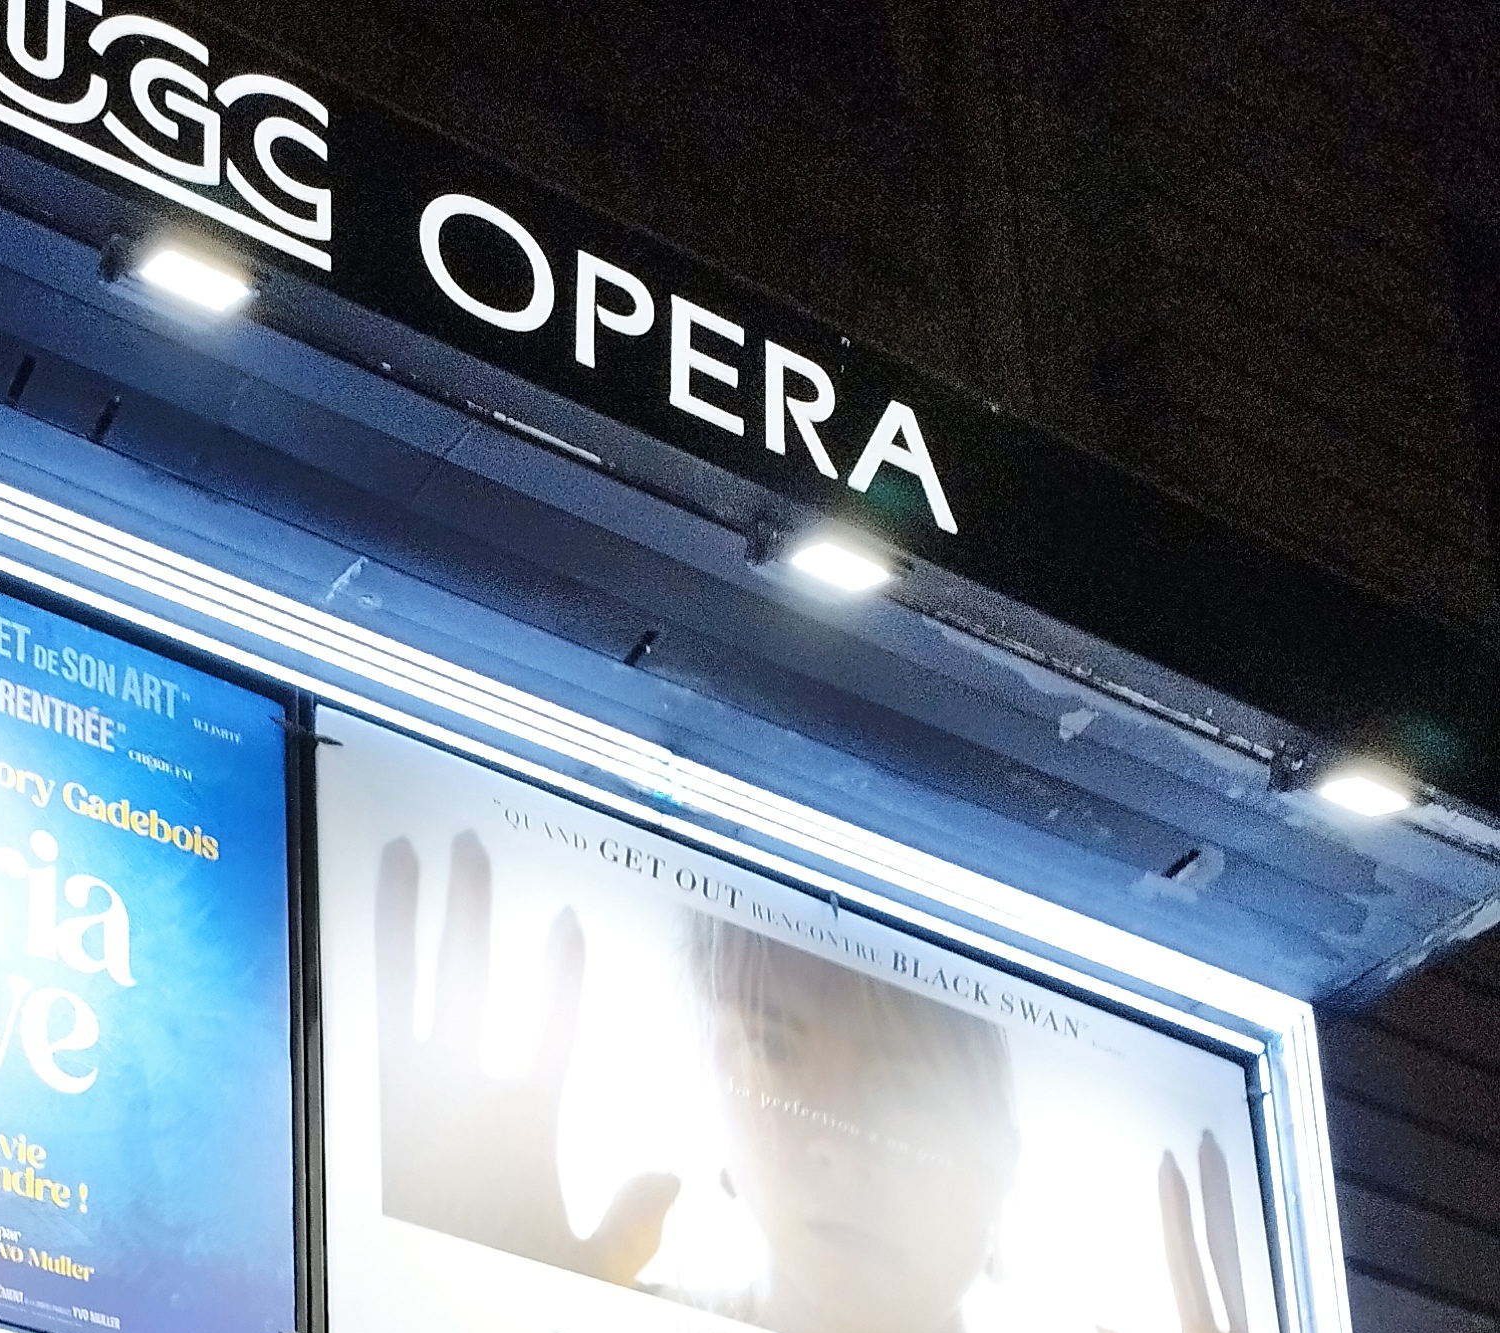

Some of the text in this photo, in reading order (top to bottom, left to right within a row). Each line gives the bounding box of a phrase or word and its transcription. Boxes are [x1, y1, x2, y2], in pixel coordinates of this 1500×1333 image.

[418, 193, 958, 534] OPERA
[34, 644, 58, 673] DE
[61, 653, 116, 694] SON
[61, 780, 220, 862] Gadebois
[598, 836, 667, 888] GET
[674, 863, 746, 910] OUT
[750, 899, 885, 966] RENCONTRE
[891, 948, 992, 1007] BLACK
[760, 1093, 861, 1136] perfection
[28, 1249, 95, 1283] Muller
